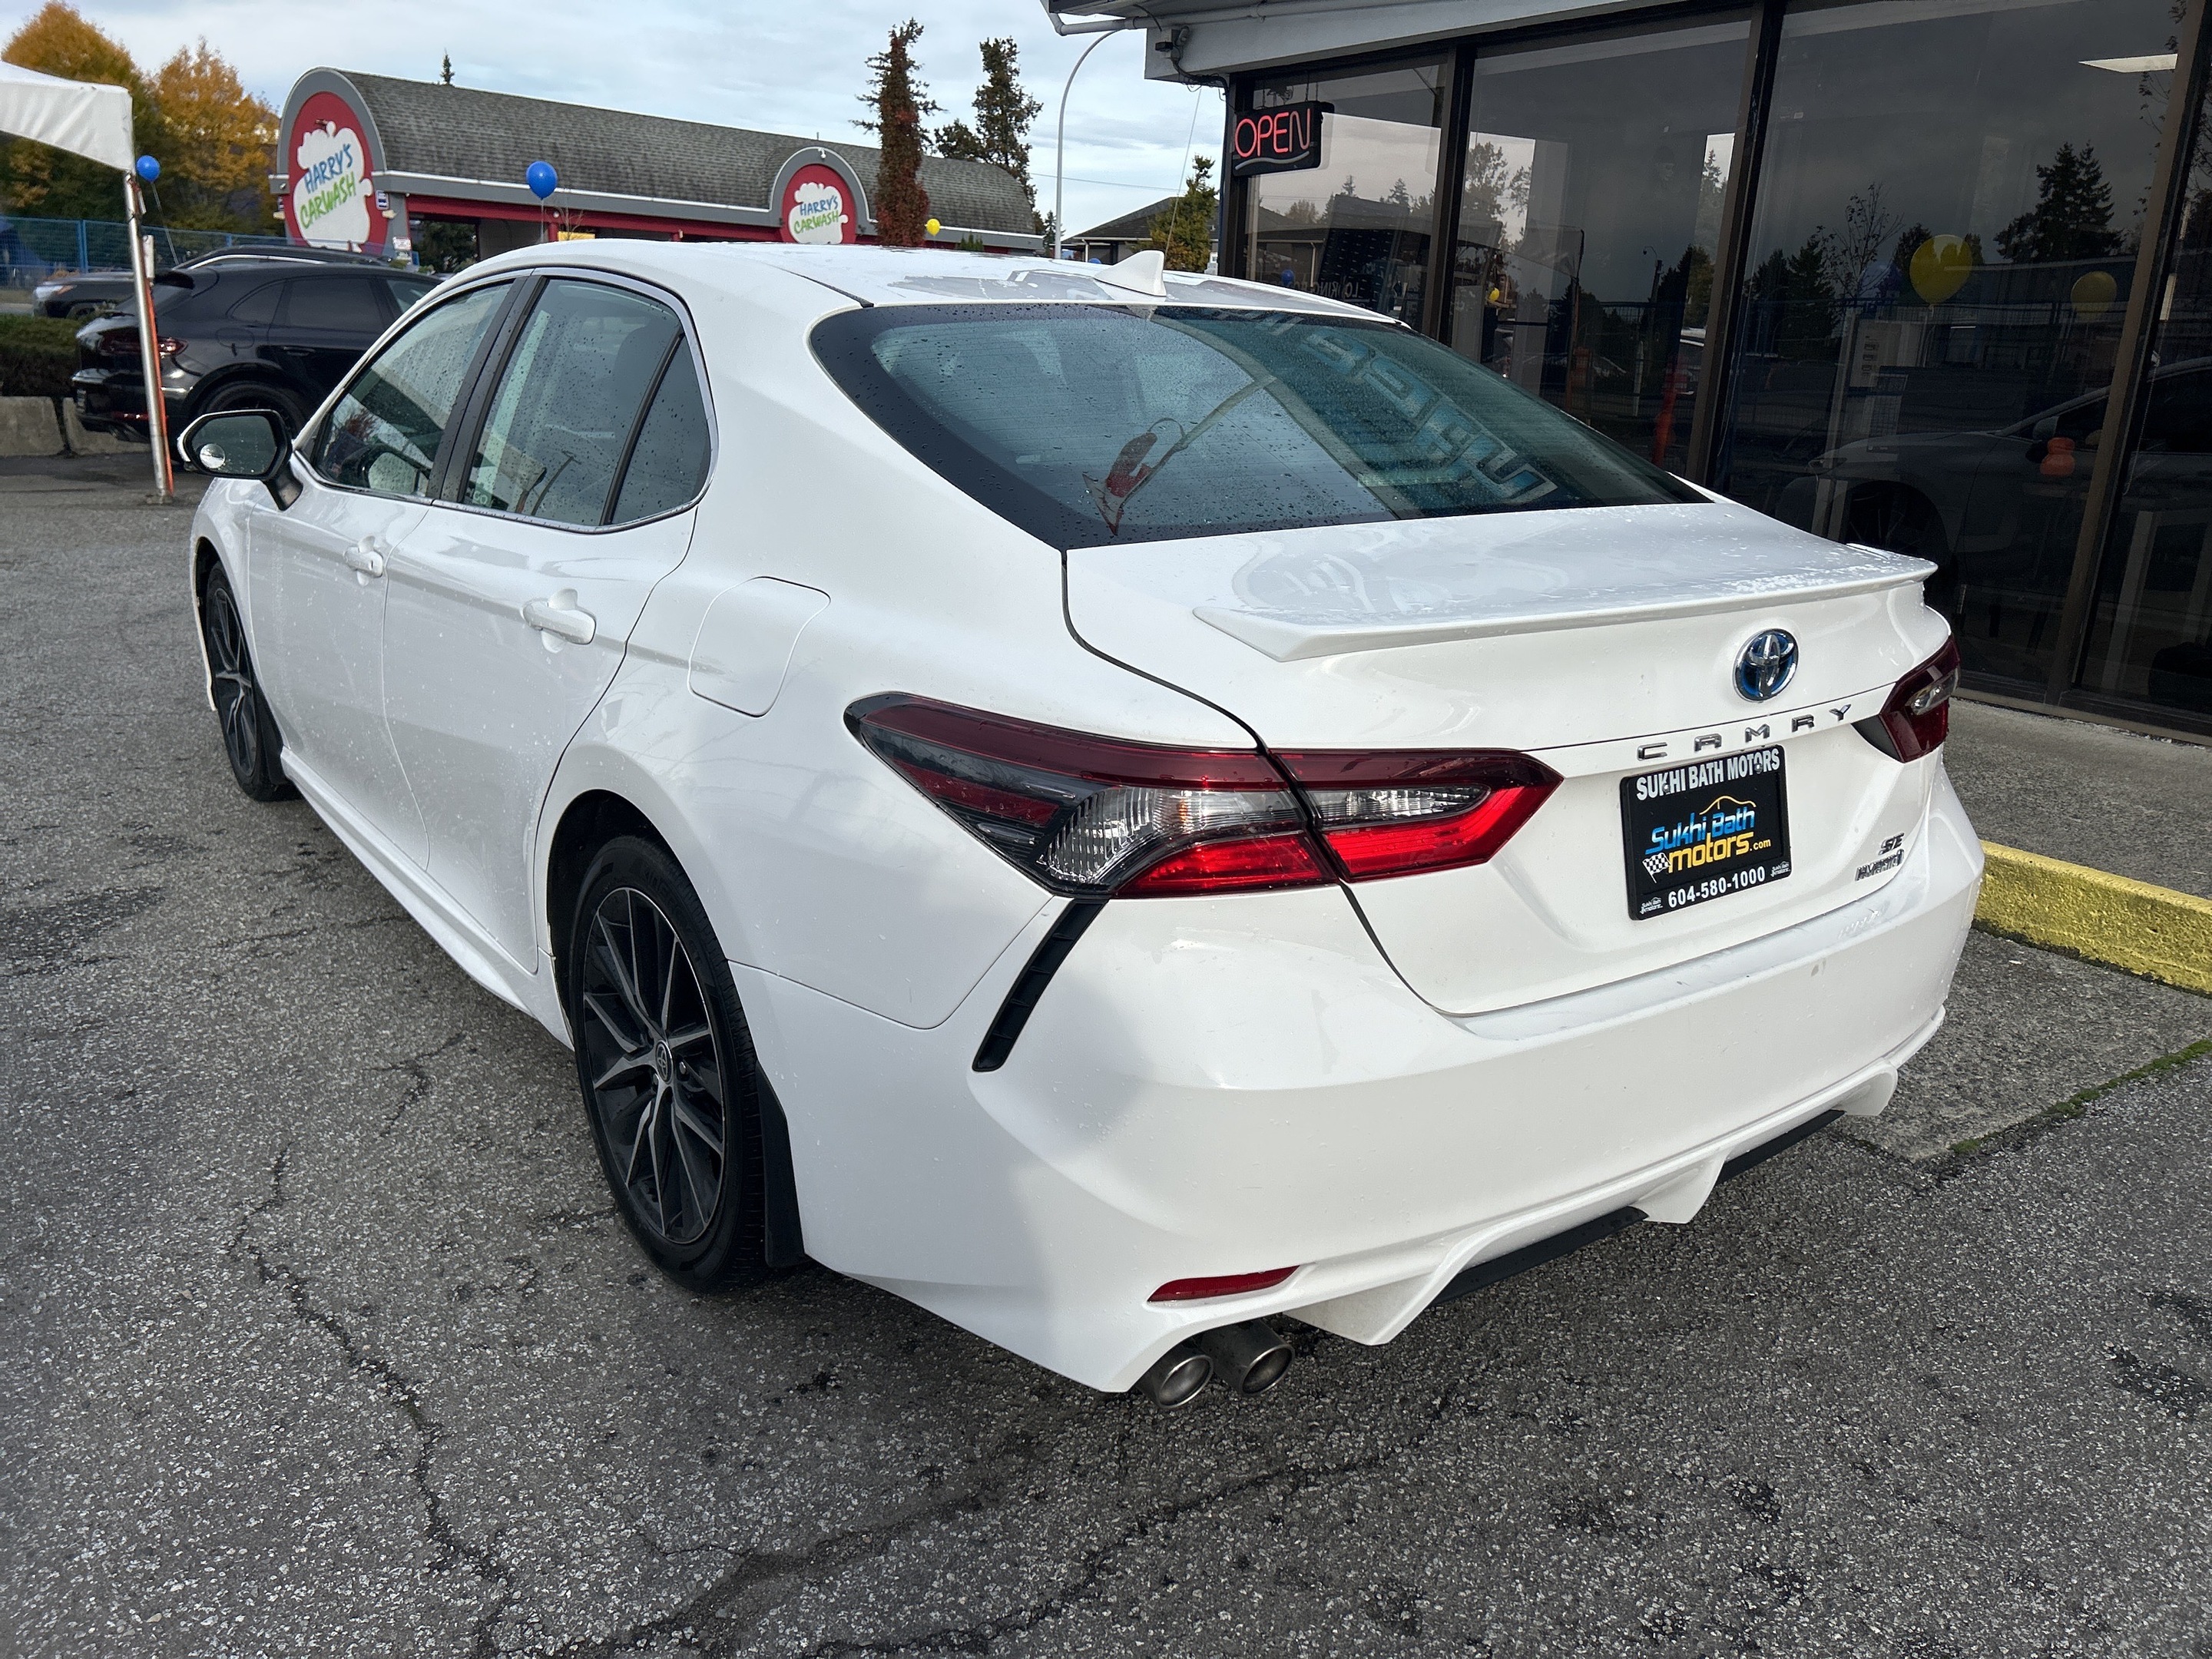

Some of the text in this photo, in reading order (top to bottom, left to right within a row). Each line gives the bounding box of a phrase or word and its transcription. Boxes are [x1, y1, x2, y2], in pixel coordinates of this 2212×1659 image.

[1234, 108, 1311, 157] OPEN
[303, 144, 353, 194] HARRY'S
[300, 171, 356, 229] CARWASH
[793, 210, 839, 234] CARWASH
[800, 195, 839, 216] HARRY'S
[1637, 704, 1852, 761] CAMRY
[1636, 748, 1780, 801] SUKHI BATH MOTORS
[1645, 806, 1755, 855] Sukhi Bath
[1878, 833, 1905, 856] SE
[1667, 866, 1766, 908] 604-580-1000
